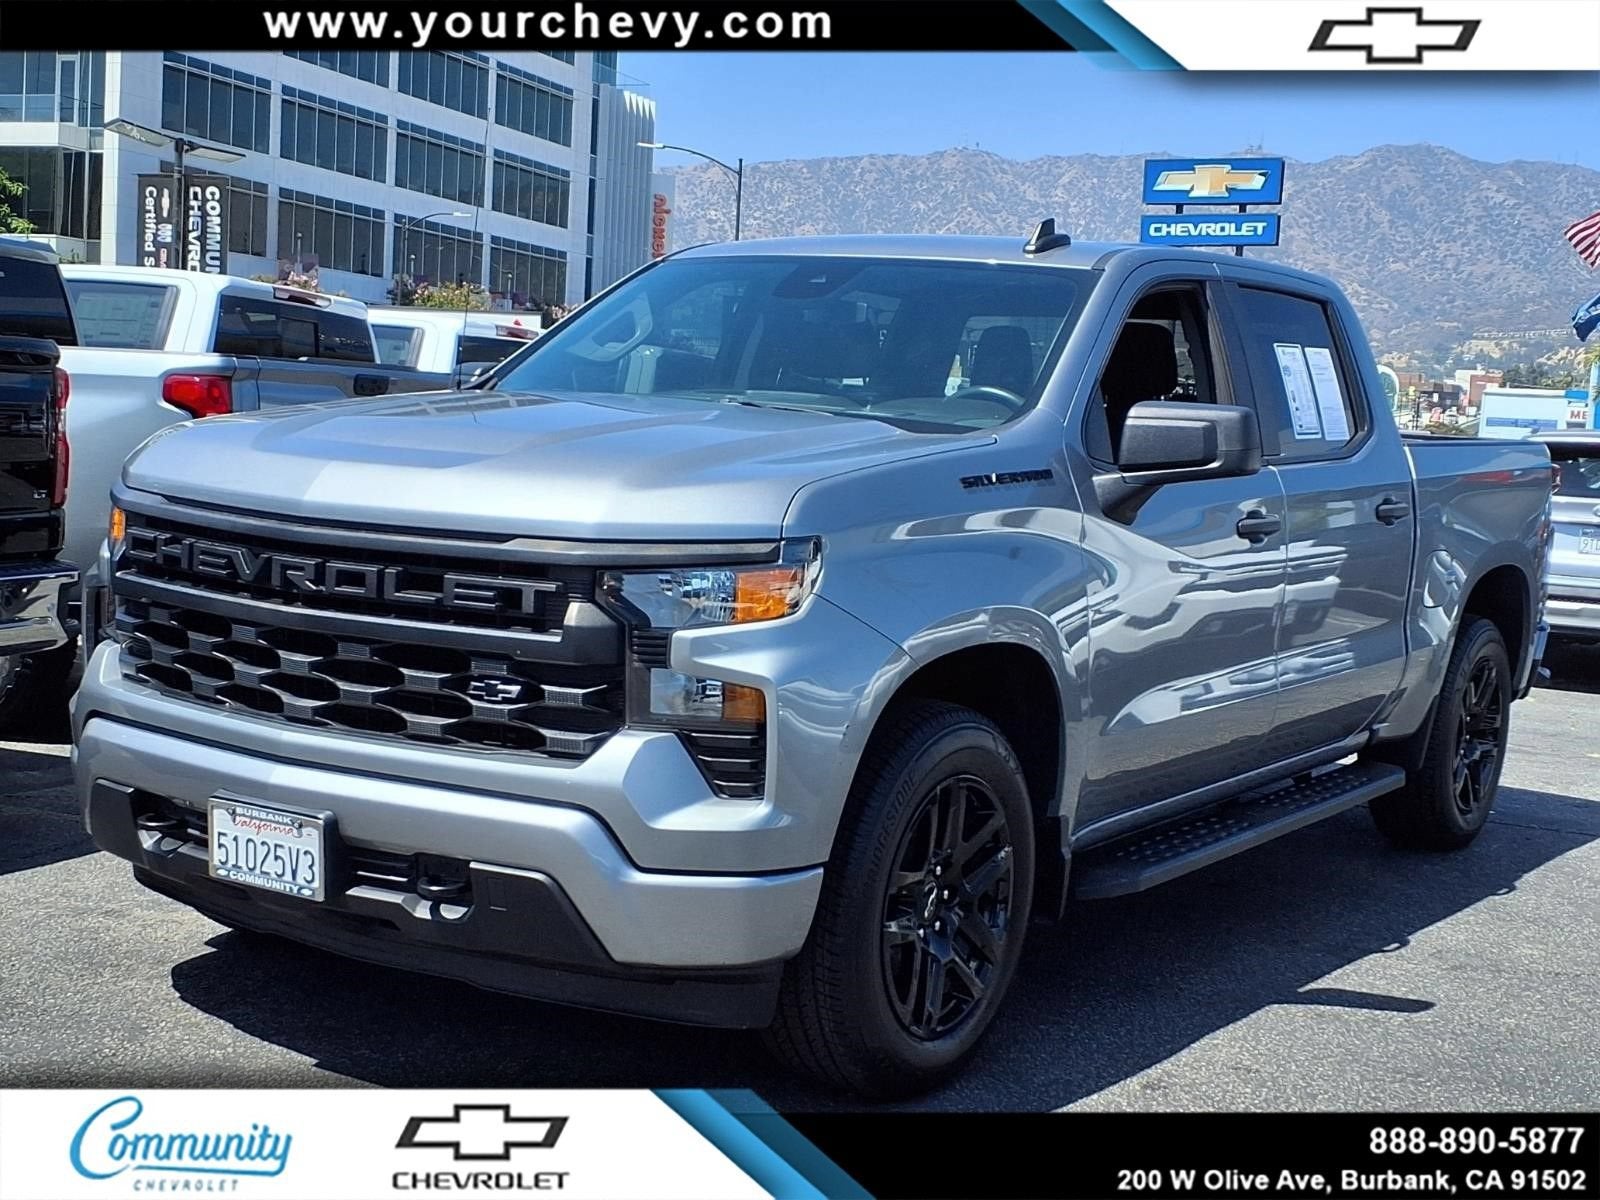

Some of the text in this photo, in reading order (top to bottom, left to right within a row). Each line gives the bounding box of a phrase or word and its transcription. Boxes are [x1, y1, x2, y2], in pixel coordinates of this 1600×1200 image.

[144, 186, 157, 252] Certified
[1149, 222, 1267, 237] CHEVROLET
[125, 526, 563, 614] CHEVROLET
[235, 807, 293, 825] BURBANK
[217, 831, 316, 885] 51025V3
[229, 870, 301, 895] COMMUNITY
